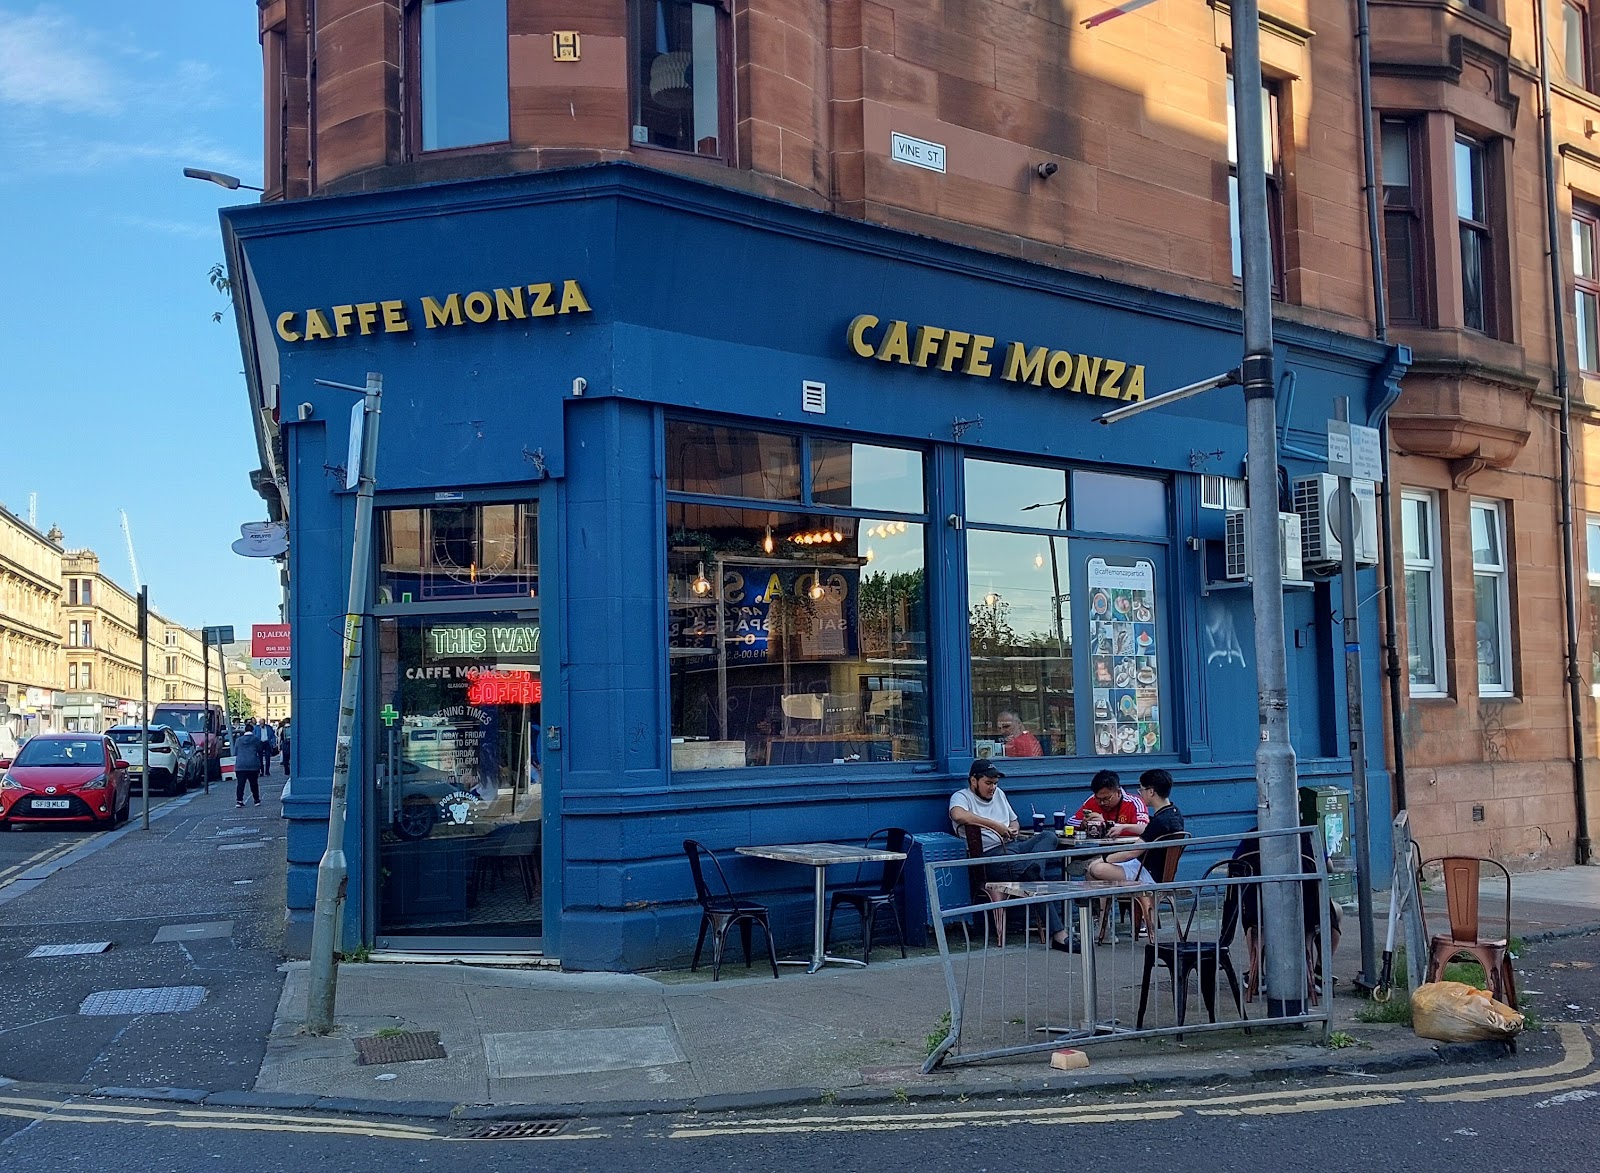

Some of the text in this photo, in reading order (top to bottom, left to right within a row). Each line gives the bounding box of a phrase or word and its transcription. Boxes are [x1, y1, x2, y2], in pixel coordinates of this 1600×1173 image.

[898, 141, 941, 163] VINE ST.
[276, 280, 592, 342] CAFFE MONZA
[847, 314, 1147, 402] CAFFE MONZA
[431, 627, 540, 653] THIS WAY
[260, 658, 278, 666] FOR
[405, 667, 451, 680] CAFFE
[470, 682, 541, 704] COFFEE
[433, 705, 492, 726] PENING TIMES
[465, 731, 486, 739] FRIDAY
[465, 739, 479, 747] 6PM
[465, 757, 479, 765] 6PM
[439, 791, 481, 807] DOGS WELCOME
